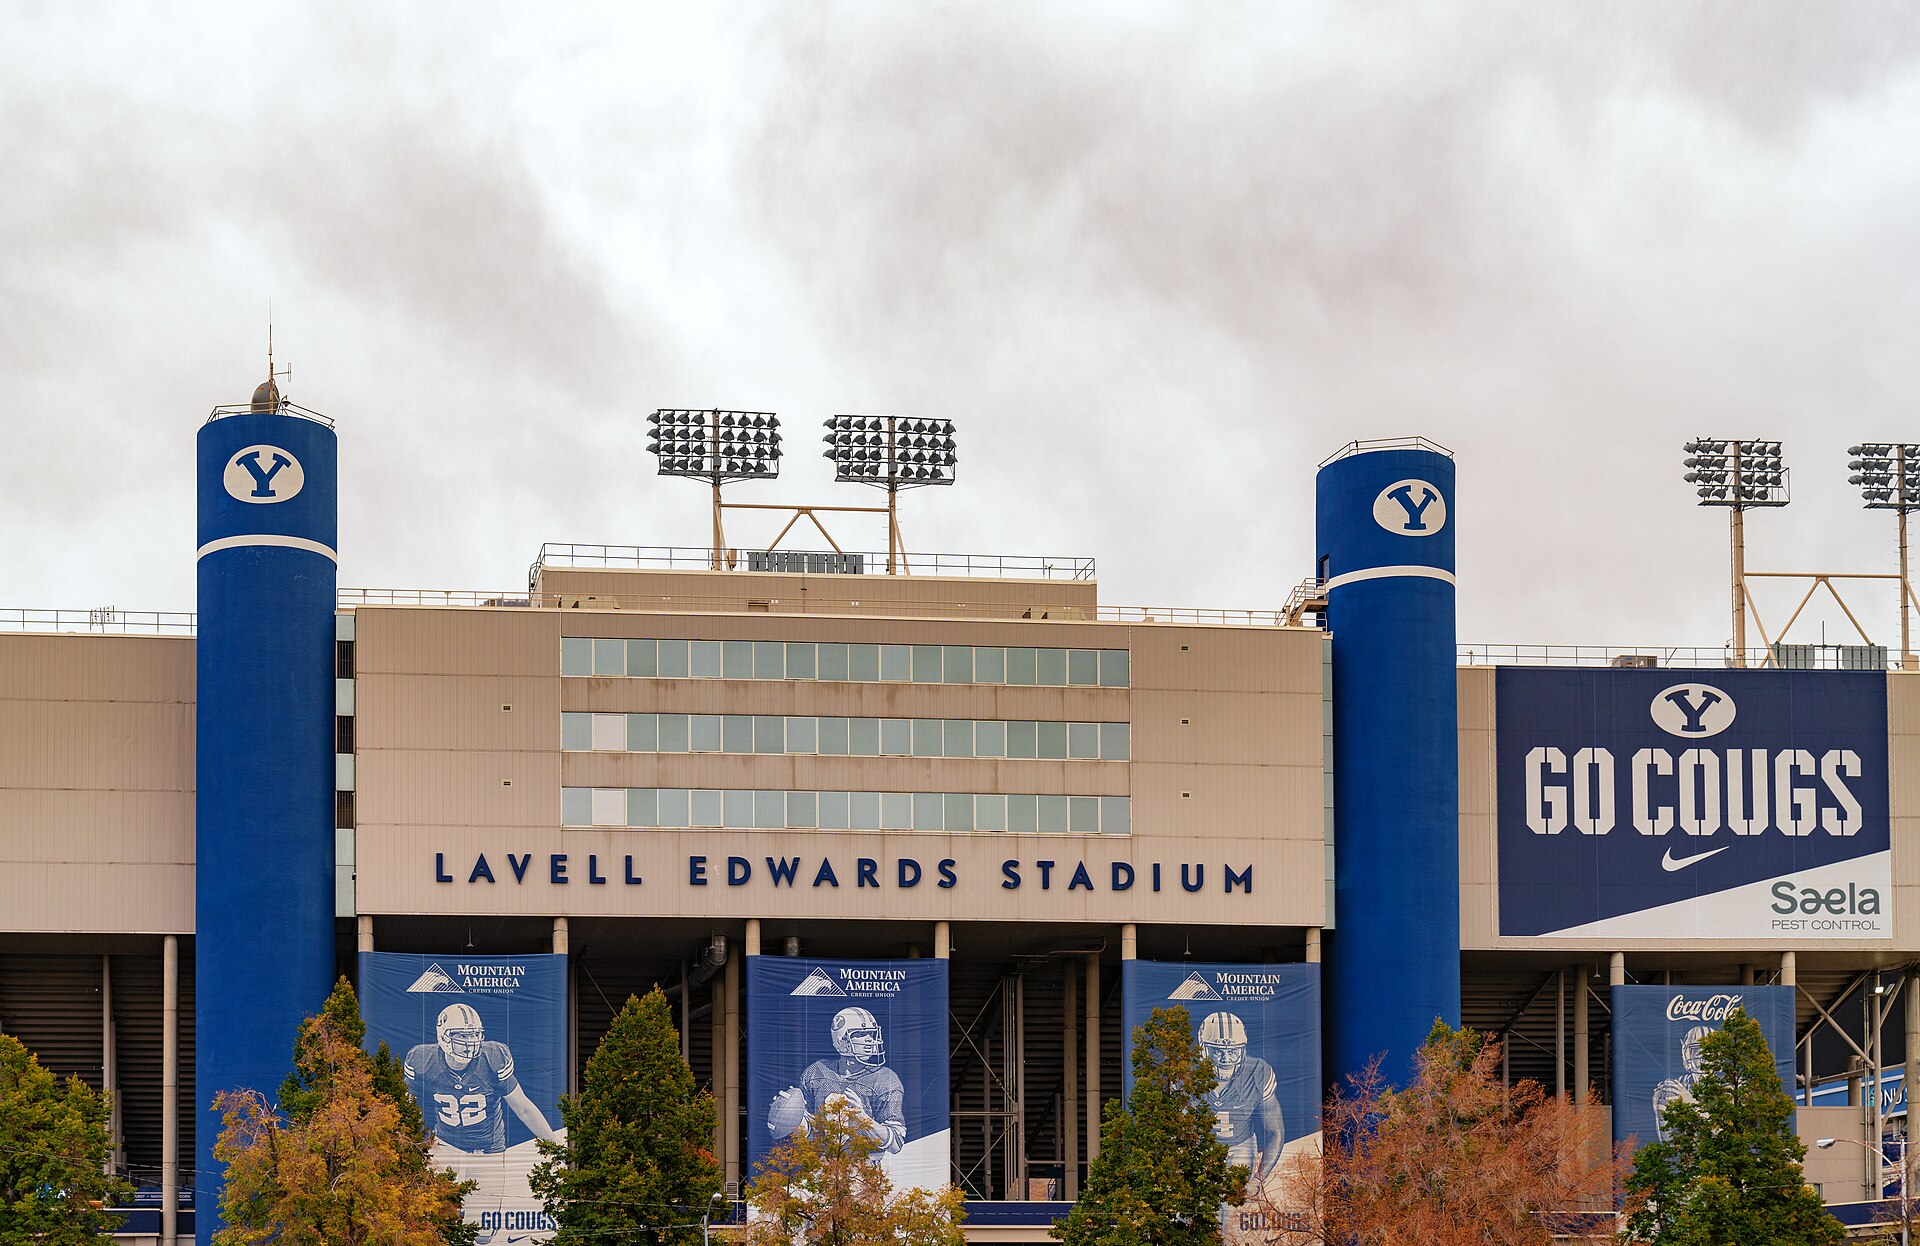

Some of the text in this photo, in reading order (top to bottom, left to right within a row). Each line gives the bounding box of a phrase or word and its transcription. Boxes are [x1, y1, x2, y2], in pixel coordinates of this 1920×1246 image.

[235, 451, 292, 497] Y
[1386, 485, 1438, 530] Y
[1664, 689, 1722, 732] Y
[1525, 746, 1863, 837] GO COUGS
[435, 852, 1253, 894] LAVELL EDWARDS STADIUM
[1770, 881, 1881, 915] Saela
[1771, 919, 1881, 931] PEST CONTROL
[457, 964, 526, 976] MOUNTAIN
[839, 968, 906, 980] MOUNTAIN
[1215, 972, 1281, 984] MOUNTAIN
[462, 976, 521, 988] AMERICA
[844, 980, 901, 992] AMERICA
[1220, 984, 1275, 996] AMERICA
[433, 1093, 487, 1127] 32
[481, 1211, 502, 1231] GO
